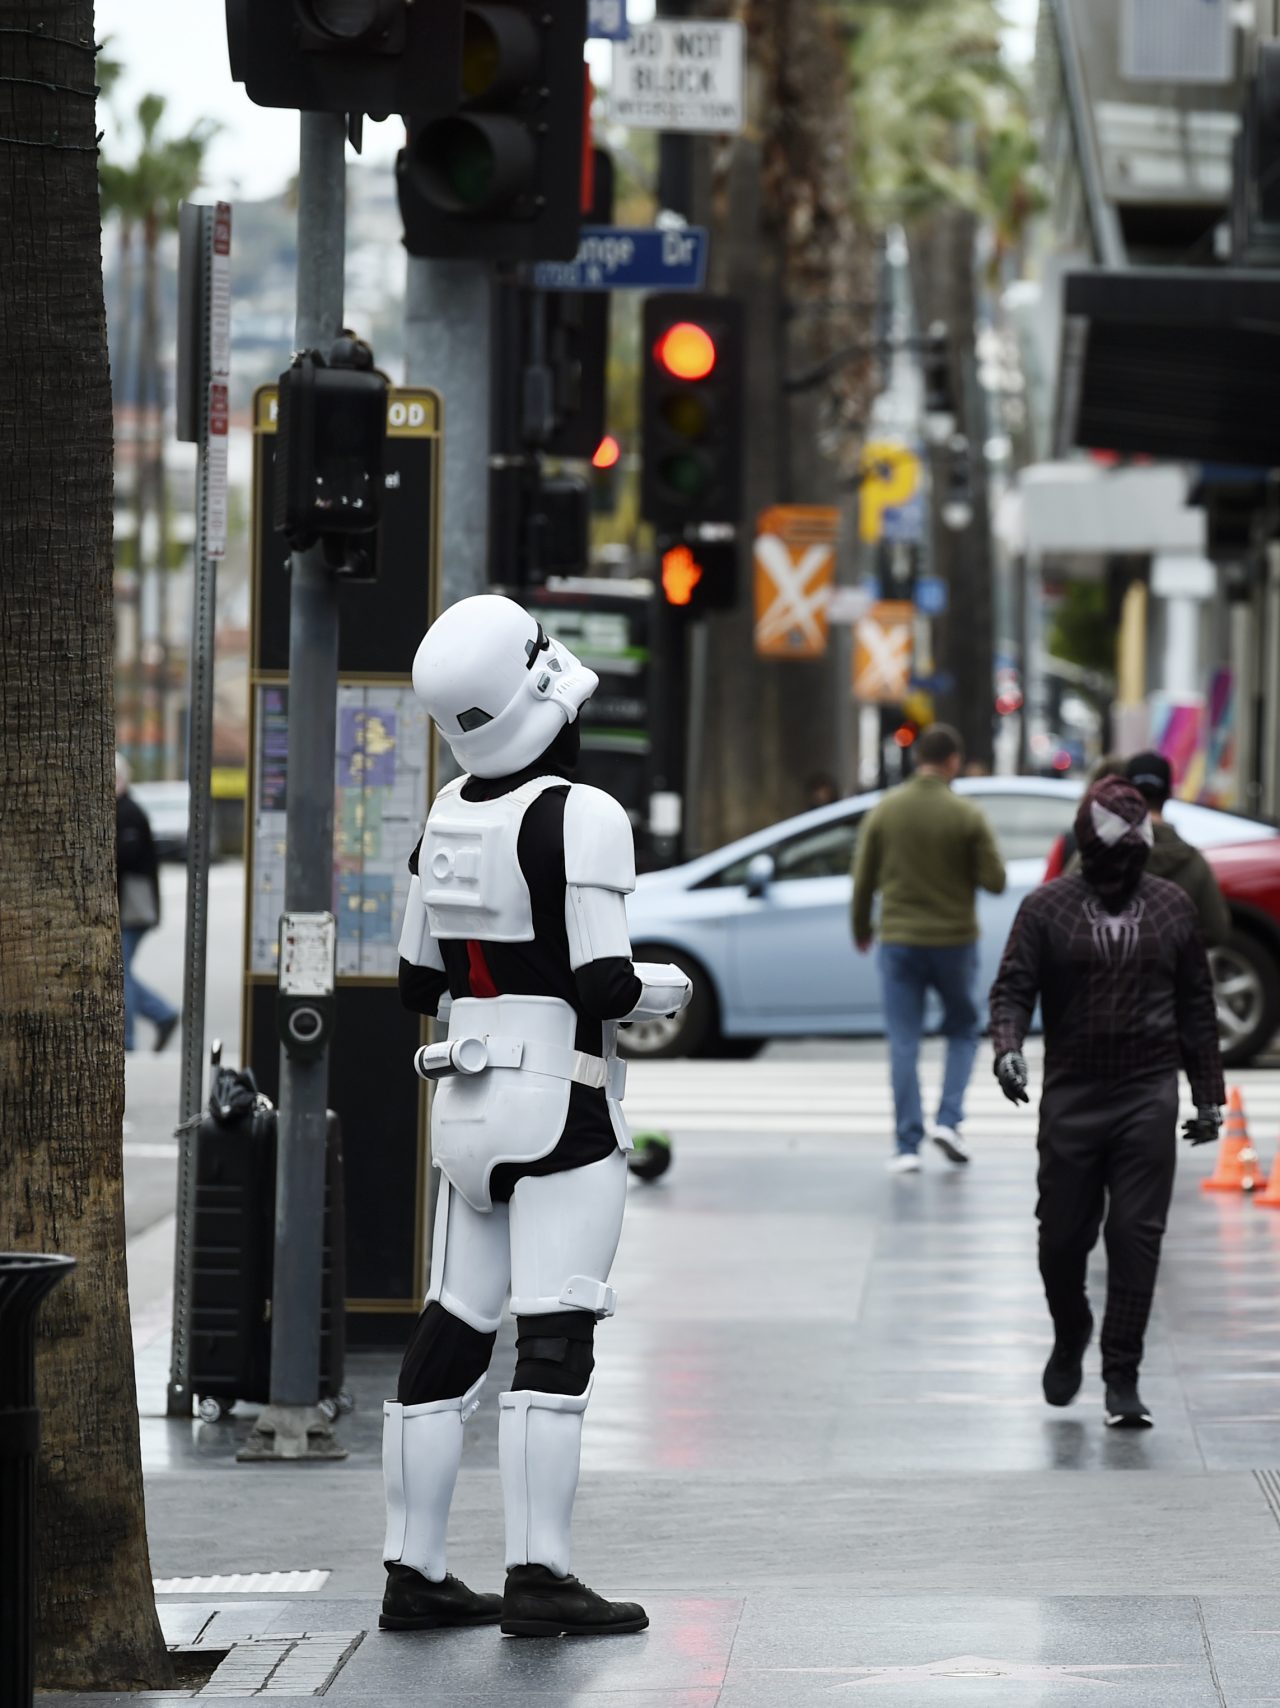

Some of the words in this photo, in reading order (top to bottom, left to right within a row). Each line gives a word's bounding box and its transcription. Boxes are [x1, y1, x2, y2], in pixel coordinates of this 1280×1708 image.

[673, 32, 721, 58] NOT
[634, 66, 718, 93] BLOCK
[661, 231, 697, 267] Dr
